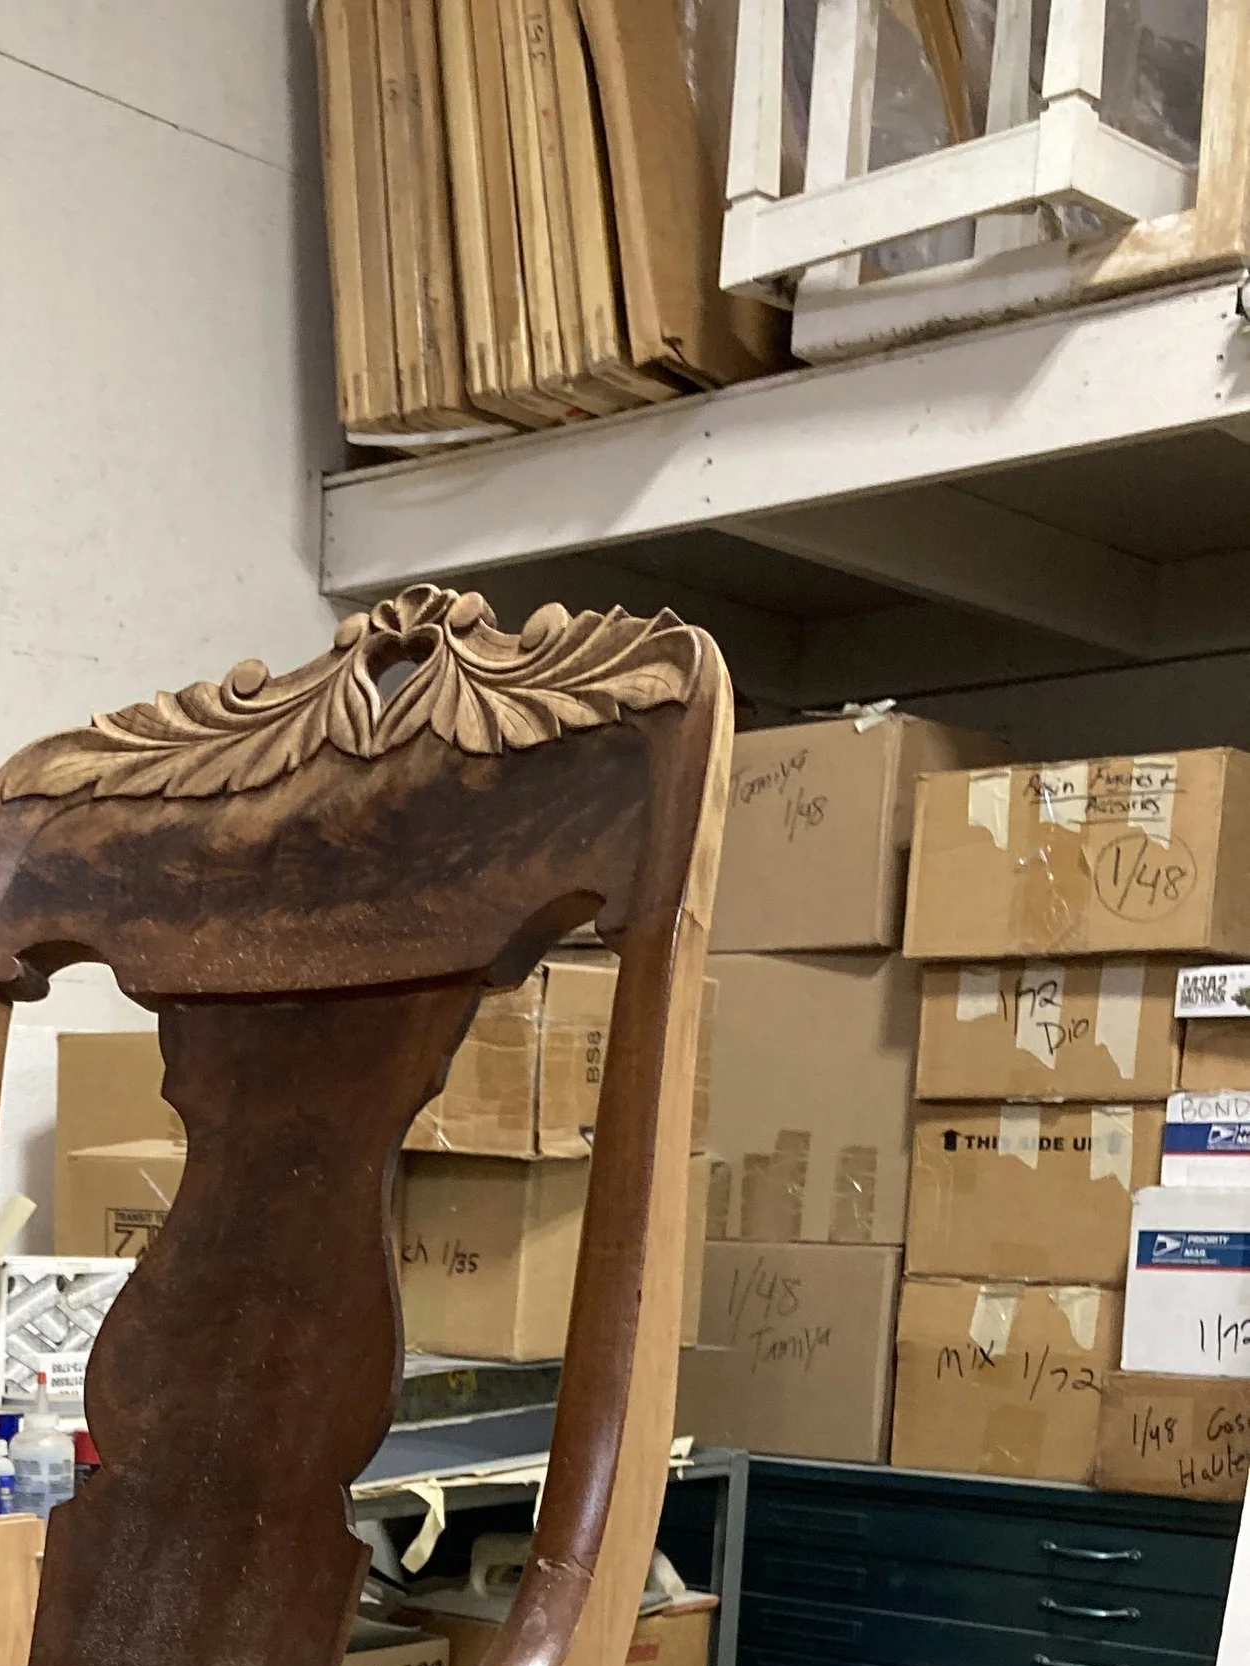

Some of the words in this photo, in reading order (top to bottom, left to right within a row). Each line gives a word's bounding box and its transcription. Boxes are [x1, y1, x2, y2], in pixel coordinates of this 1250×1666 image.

[1112, 836, 1187, 911] 1/48
[1000, 977, 1063, 1036] 1/72
[1036, 1018, 1089, 1055] Dio
[1023, 1343, 1103, 1401] 1/72
[1132, 1406, 1178, 1459] 1/48
